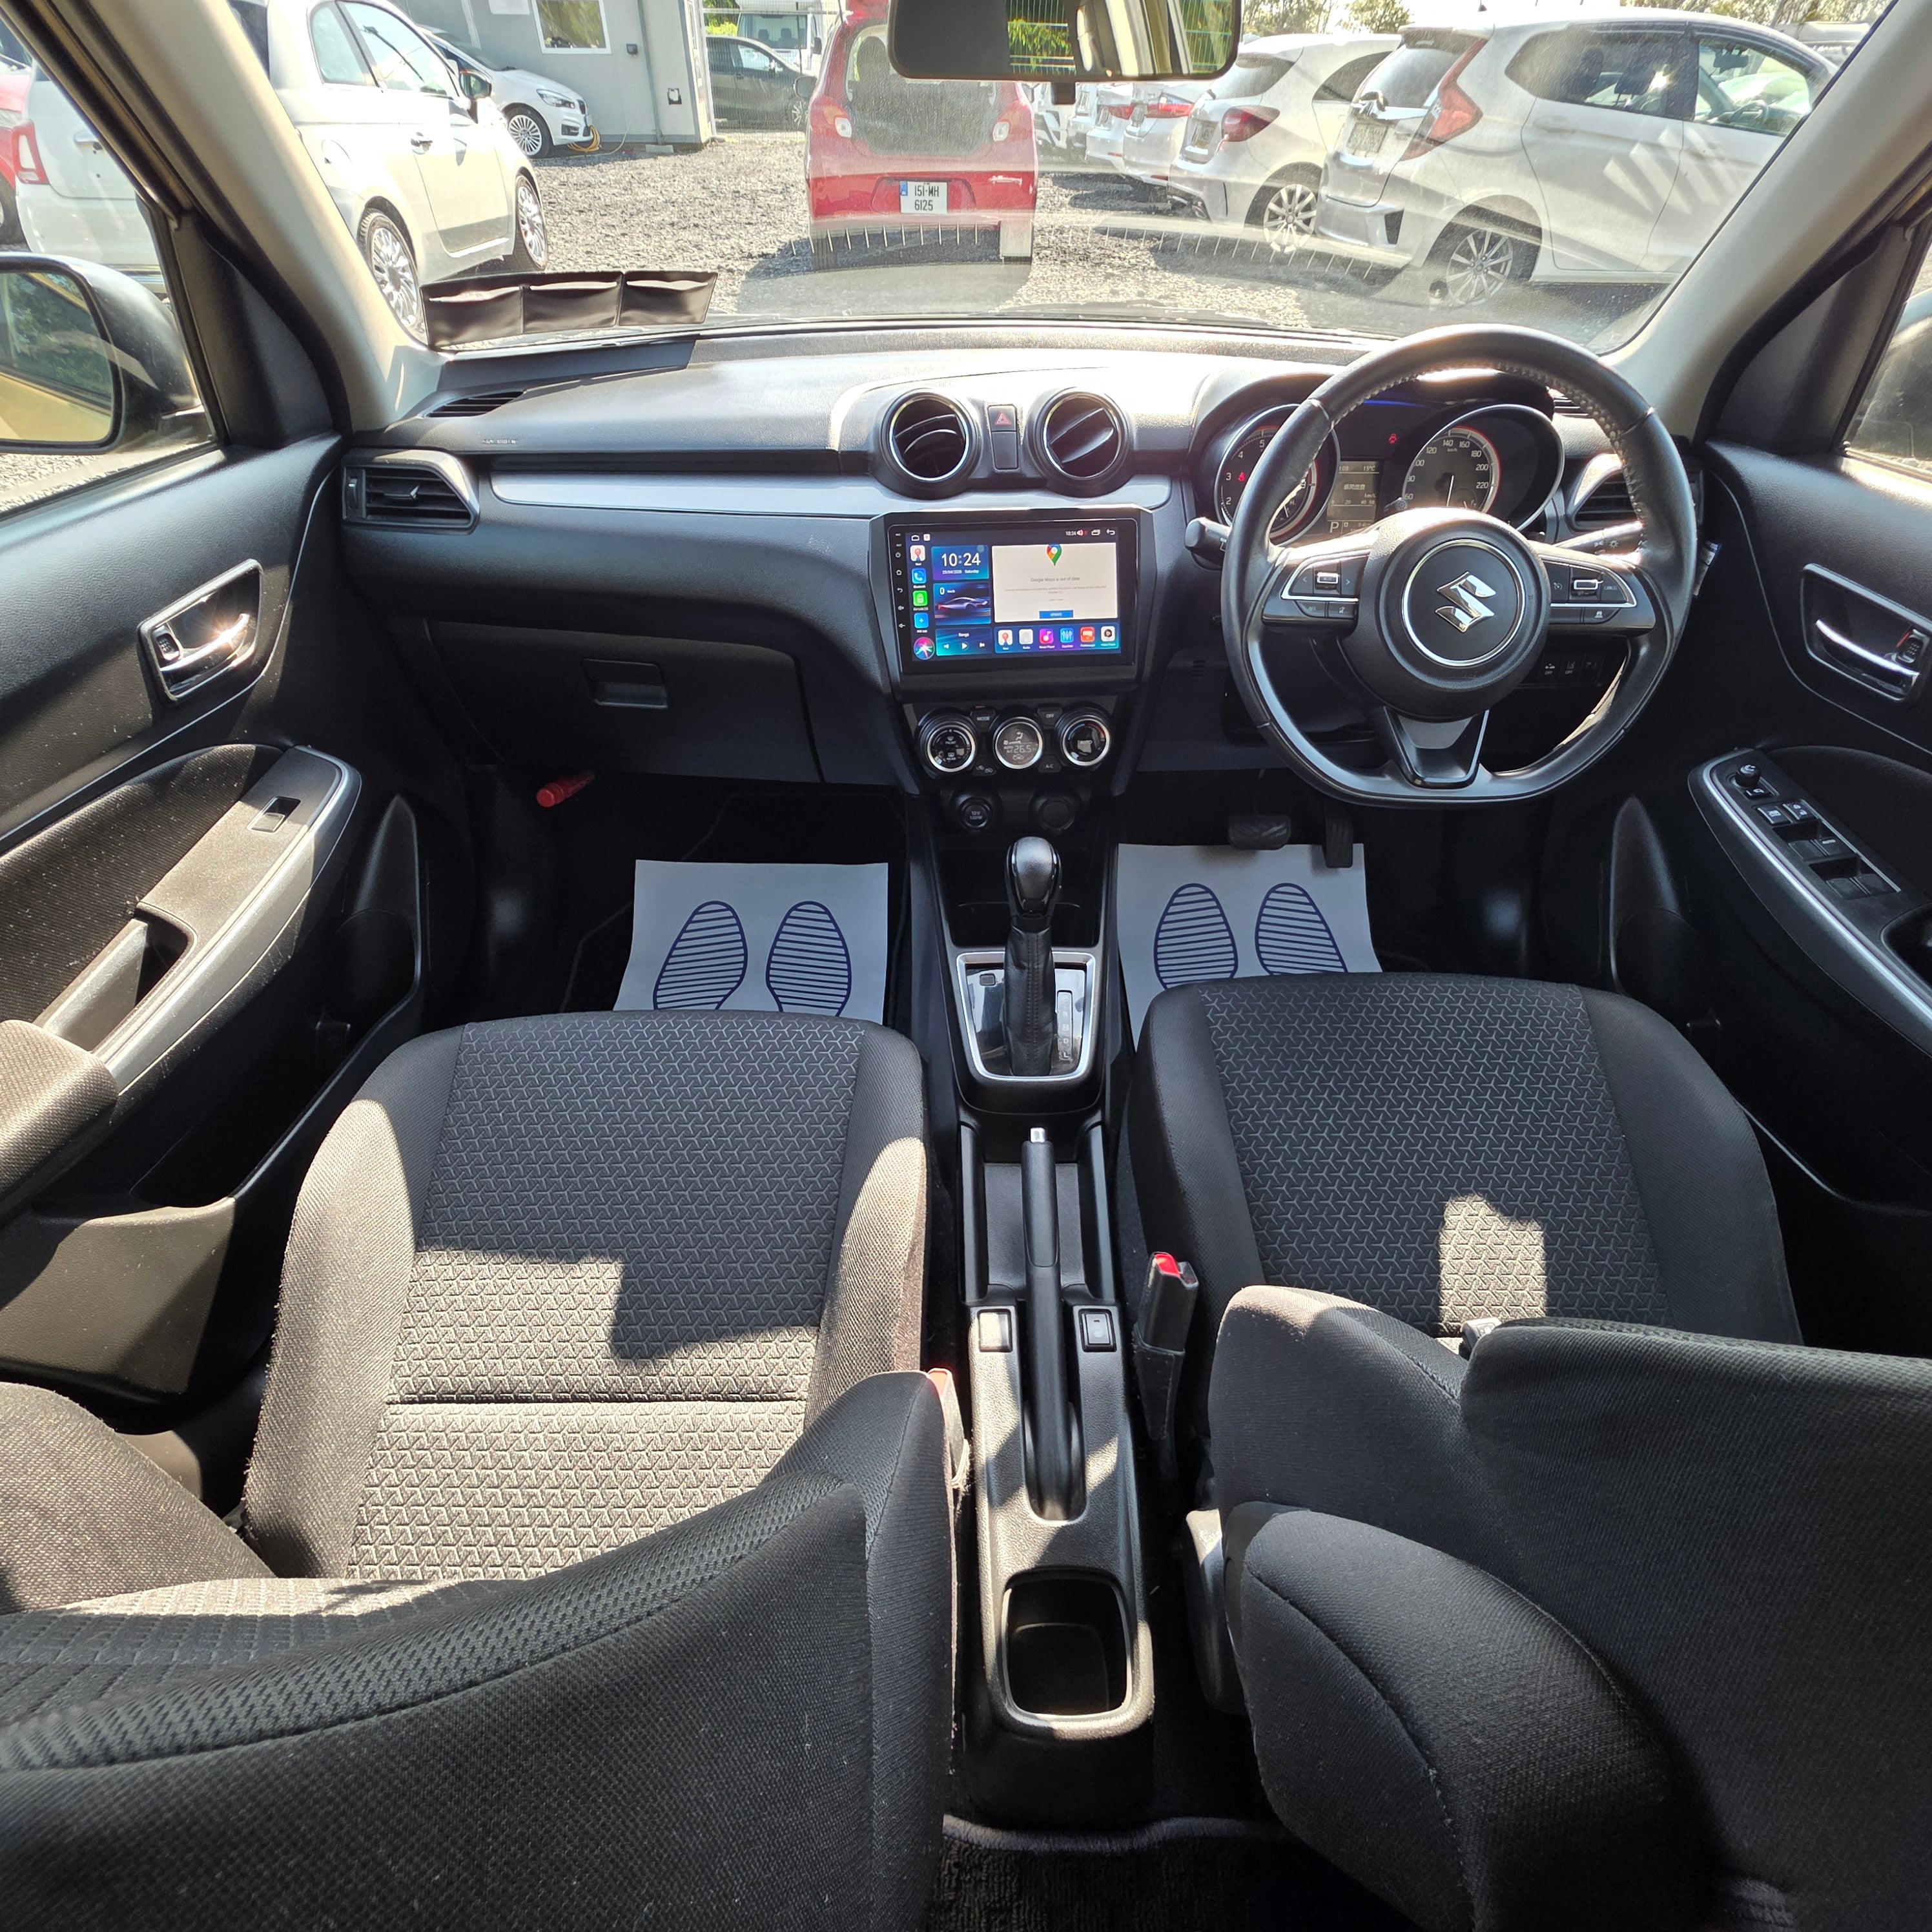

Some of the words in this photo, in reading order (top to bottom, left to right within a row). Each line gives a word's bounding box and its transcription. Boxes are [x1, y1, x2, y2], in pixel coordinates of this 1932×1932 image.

[914, 200, 934, 211] 6125
[1260, 440, 1265, 448] 5
[1238, 451, 1244, 459] 4
[1226, 473, 1232, 481] 3
[1330, 521, 1339, 533] P
[941, 552, 981, 567] 10:24
[940, 587, 945, 595] 0
[1013, 745, 1032, 753] 26.5
